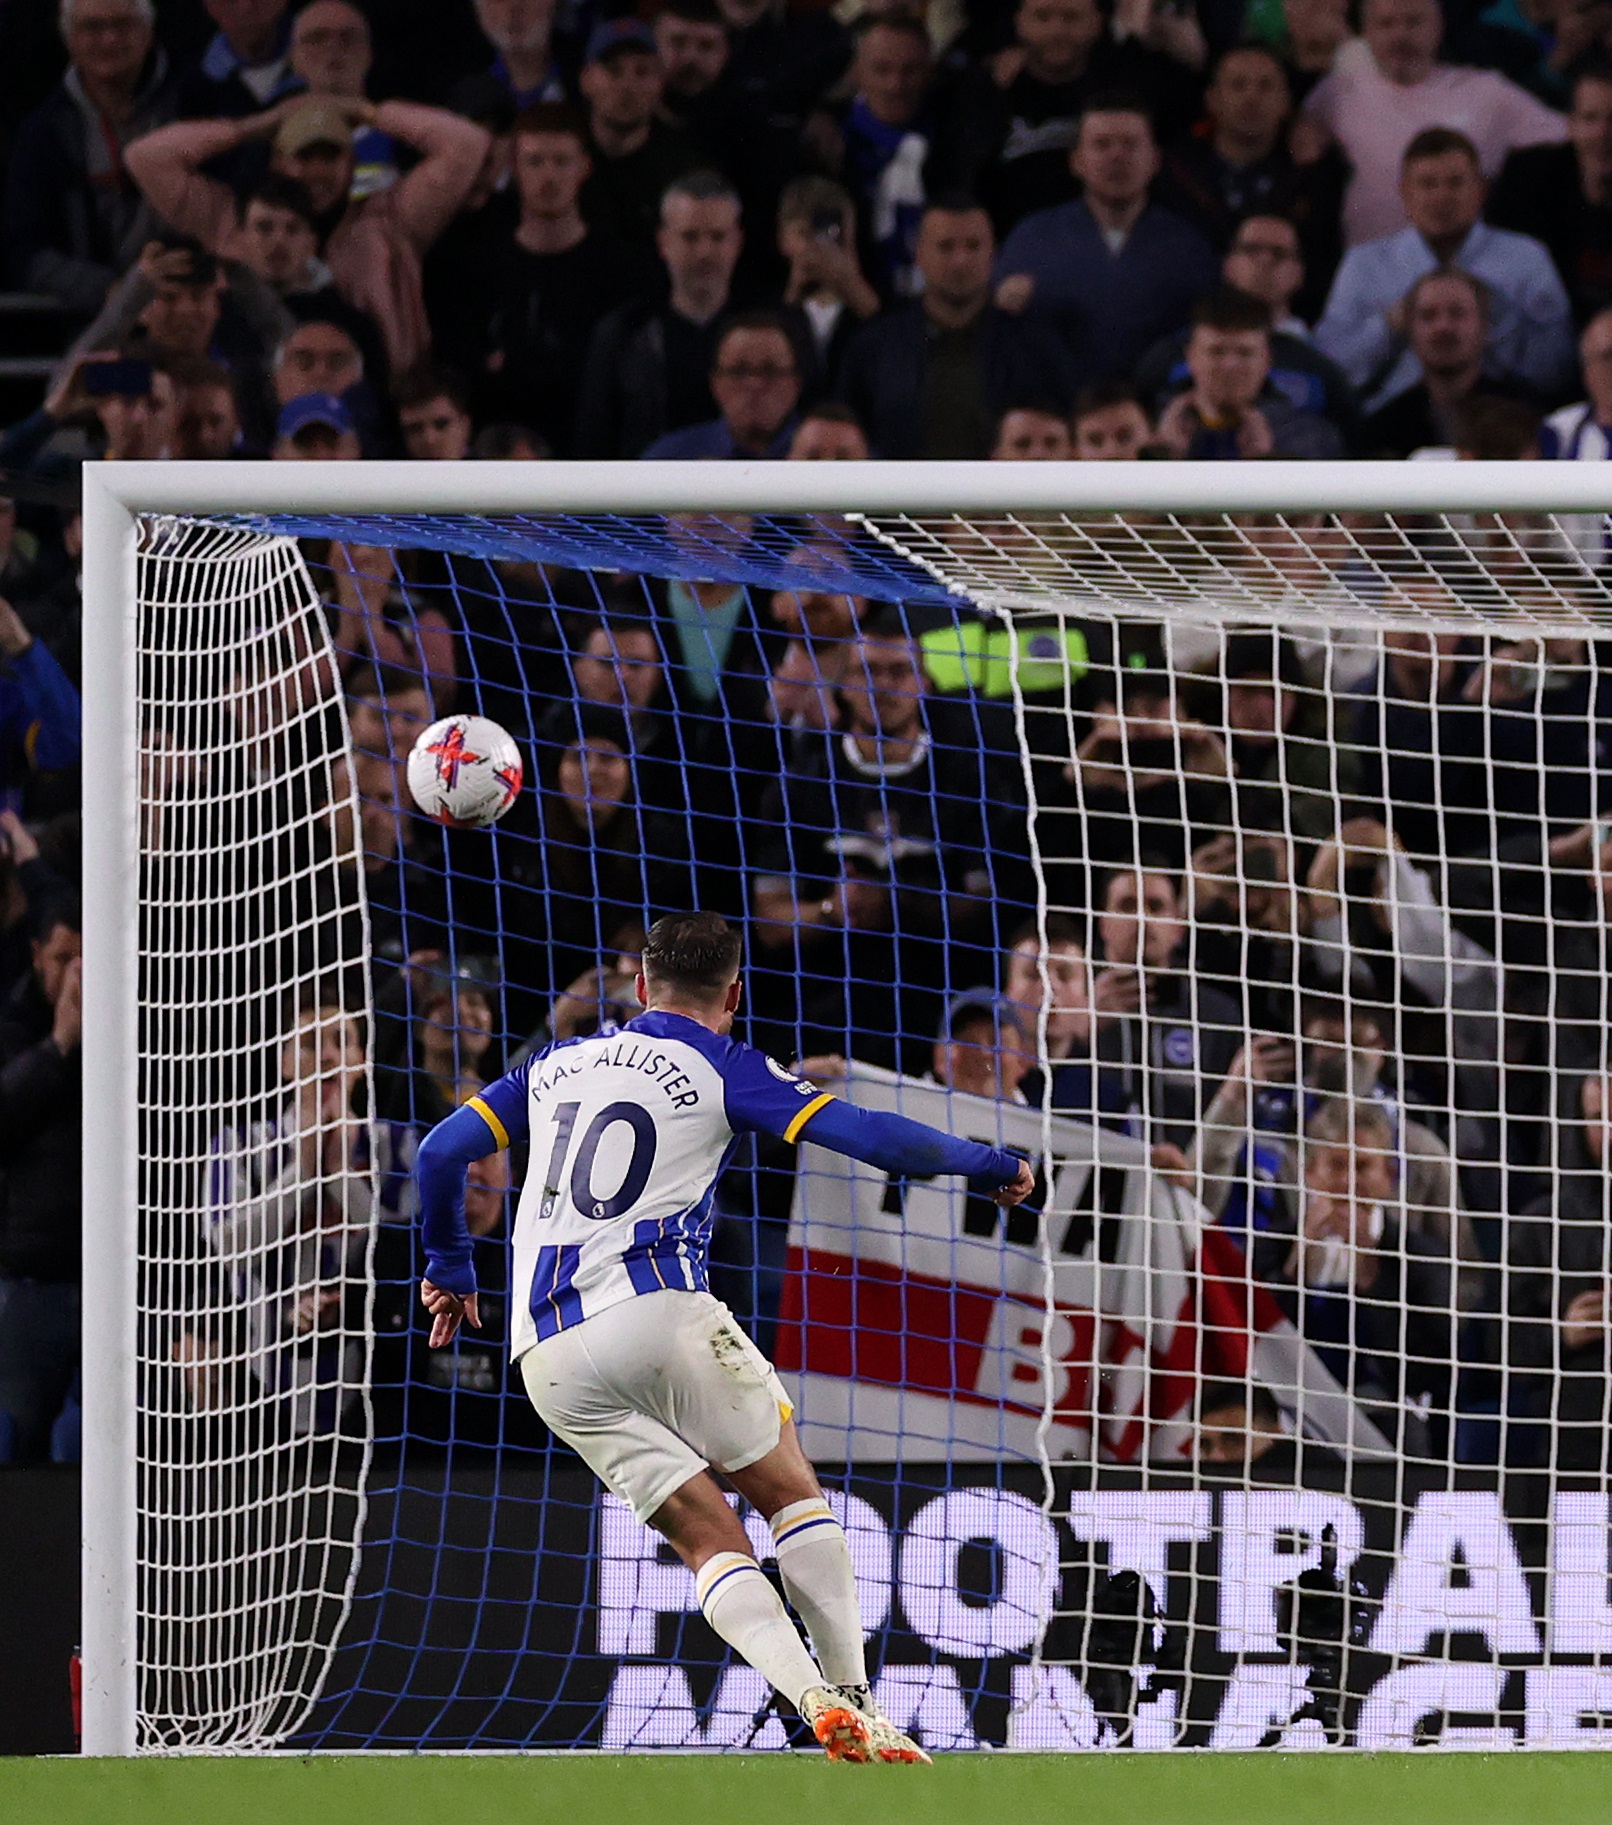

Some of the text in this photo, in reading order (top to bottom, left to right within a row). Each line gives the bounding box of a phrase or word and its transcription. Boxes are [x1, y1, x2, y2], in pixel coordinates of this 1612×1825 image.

[531, 1043, 700, 1111] MAC ALLISTER
[538, 1100, 658, 1221] 10
